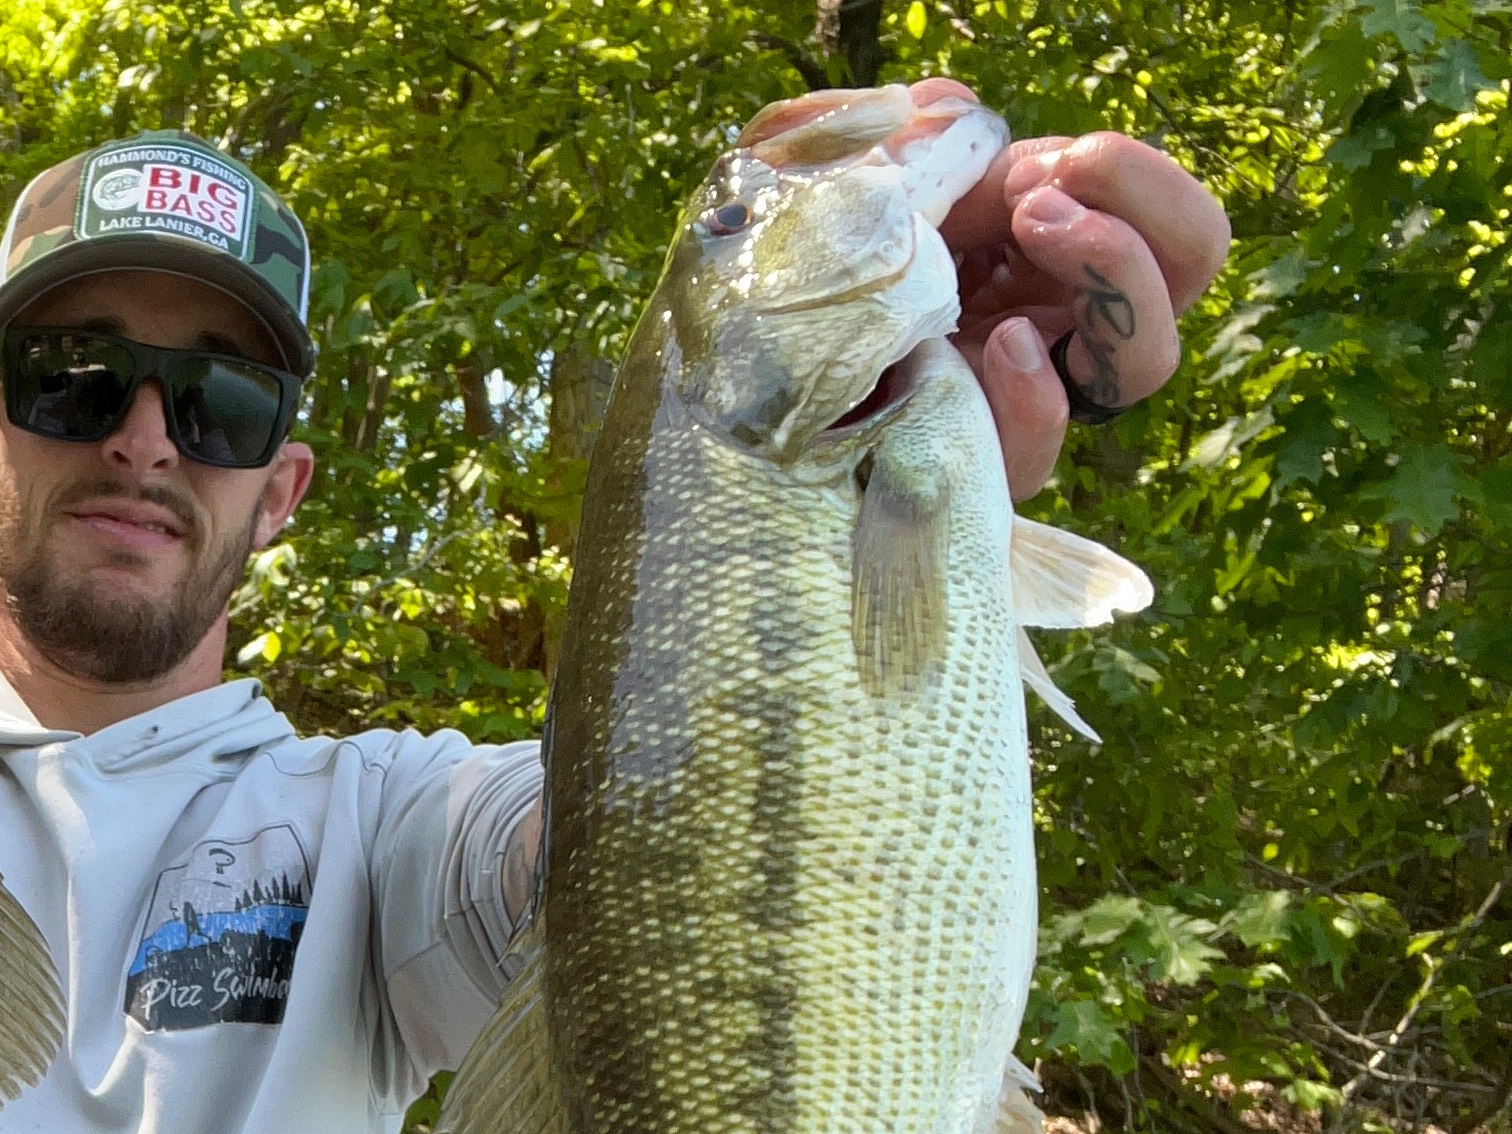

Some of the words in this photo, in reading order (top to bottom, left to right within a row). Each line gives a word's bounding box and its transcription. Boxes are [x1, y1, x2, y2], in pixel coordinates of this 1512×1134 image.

[98, 150, 191, 167] HAMMOND'S
[192, 157, 247, 190] FISHING
[150, 167, 238, 210] BIG
[99, 216, 143, 231] LAKE
[145, 190, 236, 234] BASS
[140, 977, 202, 1021] Pizz
